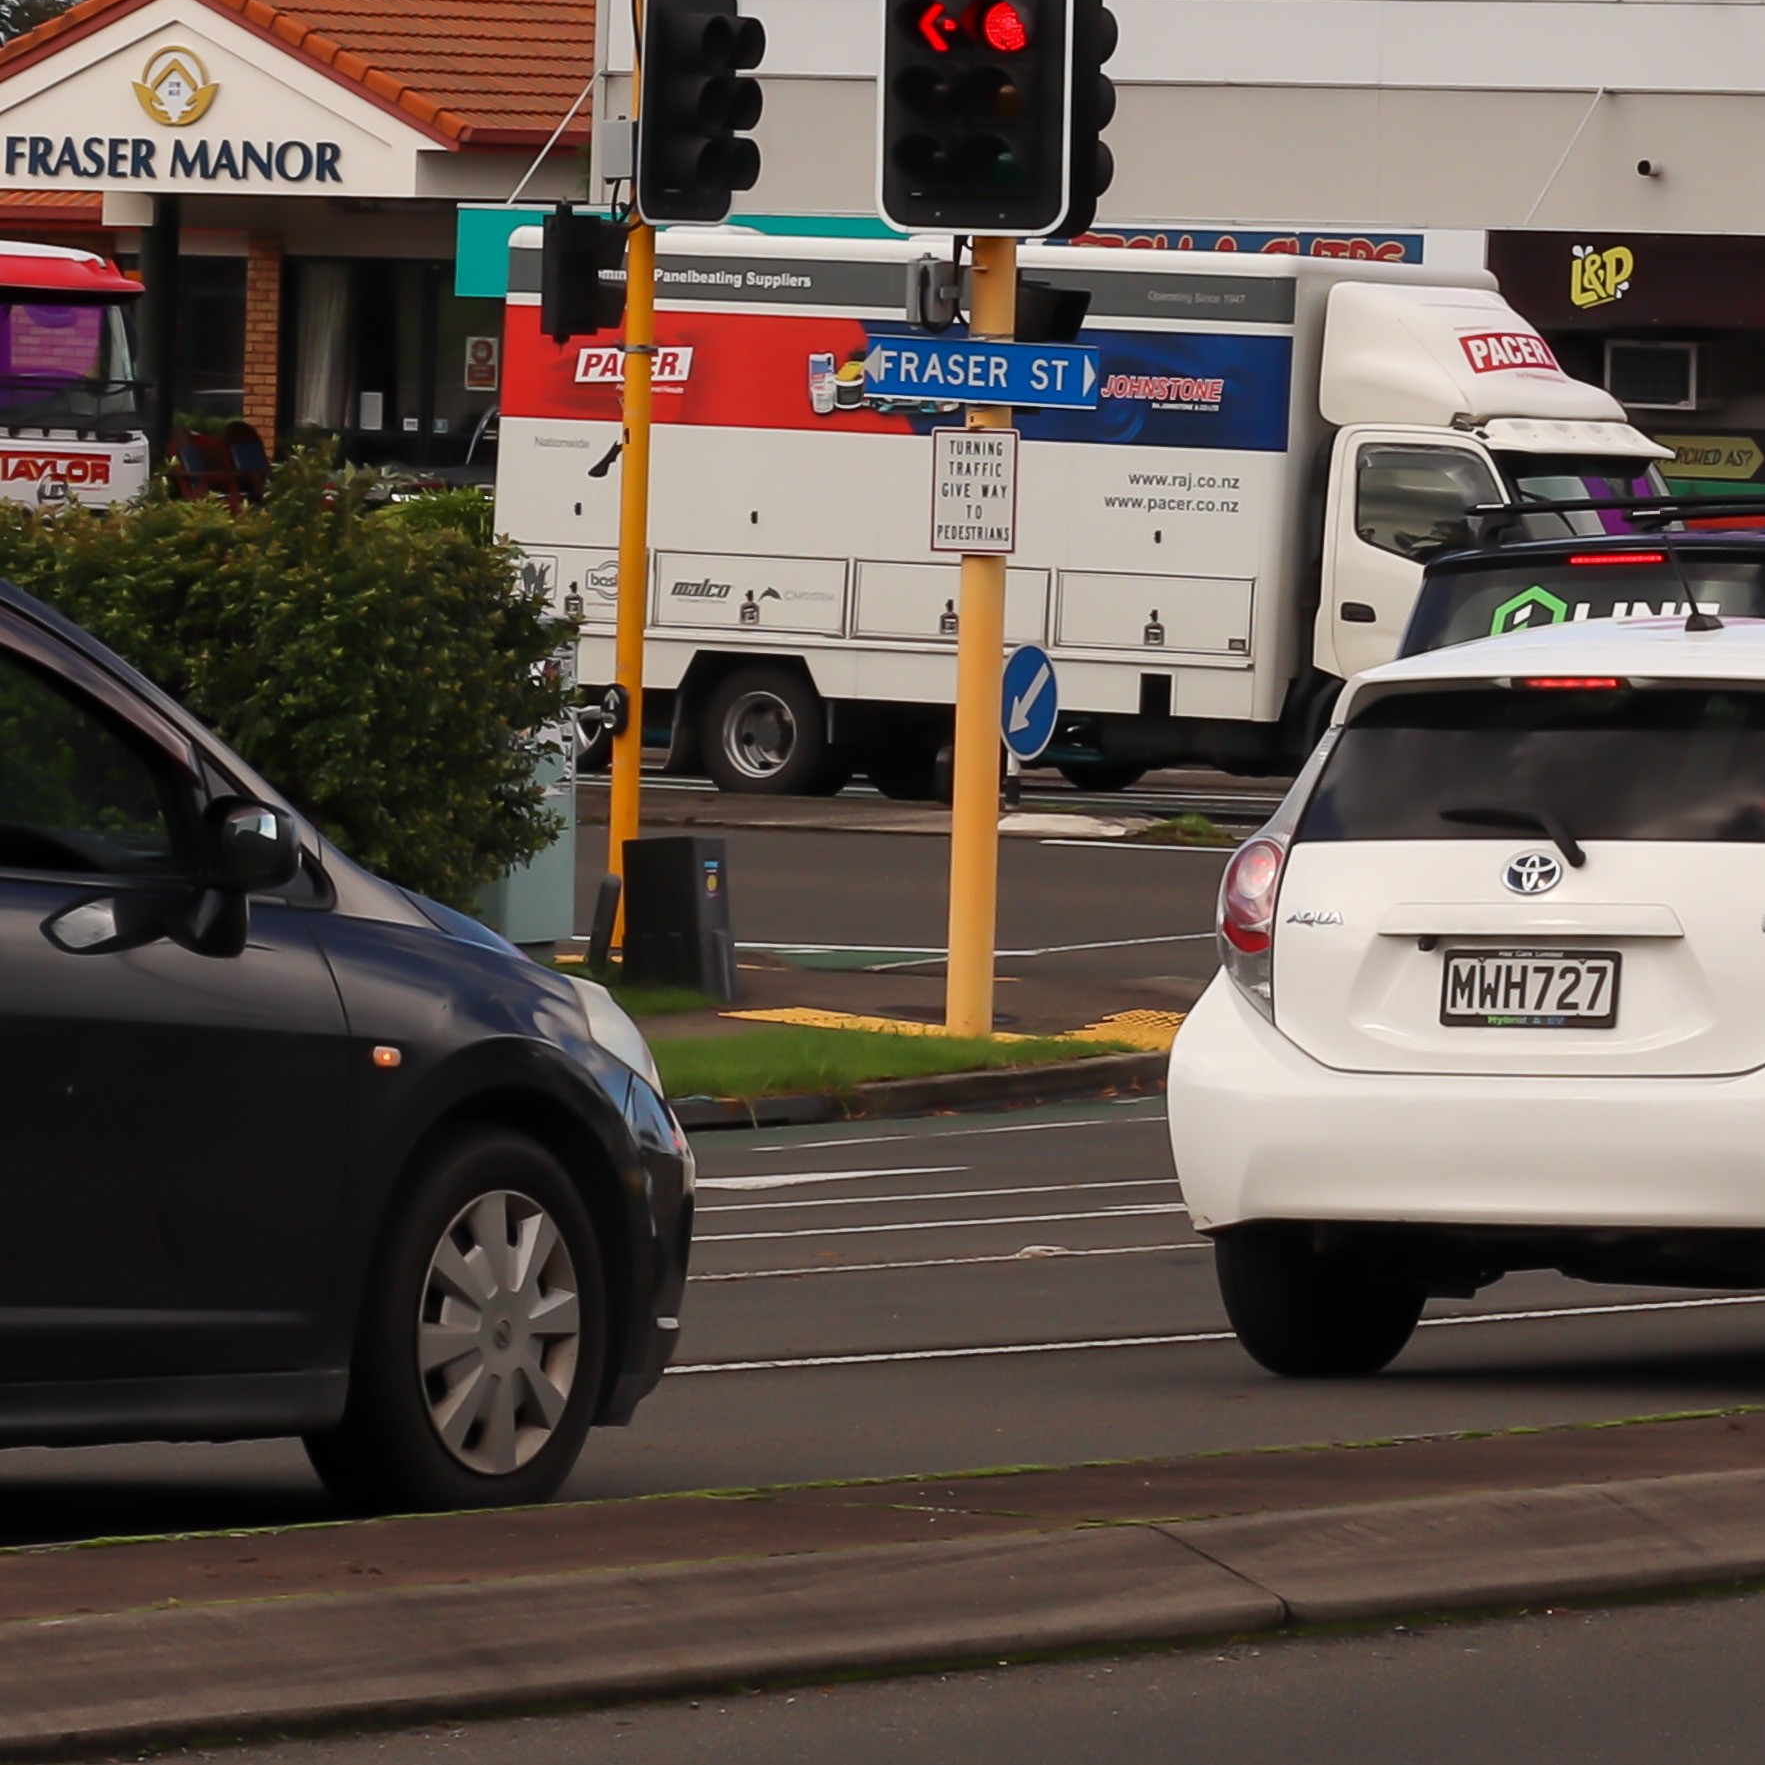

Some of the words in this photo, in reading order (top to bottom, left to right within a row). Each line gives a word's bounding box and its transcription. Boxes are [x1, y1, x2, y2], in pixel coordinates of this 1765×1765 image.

[5, 136, 157, 179] FRASER
[169, 139, 343, 183] MANOR
[653, 268, 743, 289] Panelbeating
[745, 270, 812, 290] Suppliers
[1466, 335, 1552, 370] PACER
[581, 352, 681, 378] PAR
[880, 347, 1008, 388] FRASER
[1030, 359, 1069, 392] ST
[1101, 374, 1225, 403] JOHNSTONE
[949, 439, 1004, 457] TURNING
[948, 460, 1003, 478] TRAFFIC
[941, 482, 971, 499] GIVE
[980, 483, 1008, 500] WAY
[1128, 472, 1240, 493] www.raj.co.nz
[965, 504, 983, 521] TO
[1103, 494, 1240, 514] www.pacer.co.nz
[936, 524, 1010, 543] PEDESTRIANS
[1449, 964, 1609, 1011] MWH727
